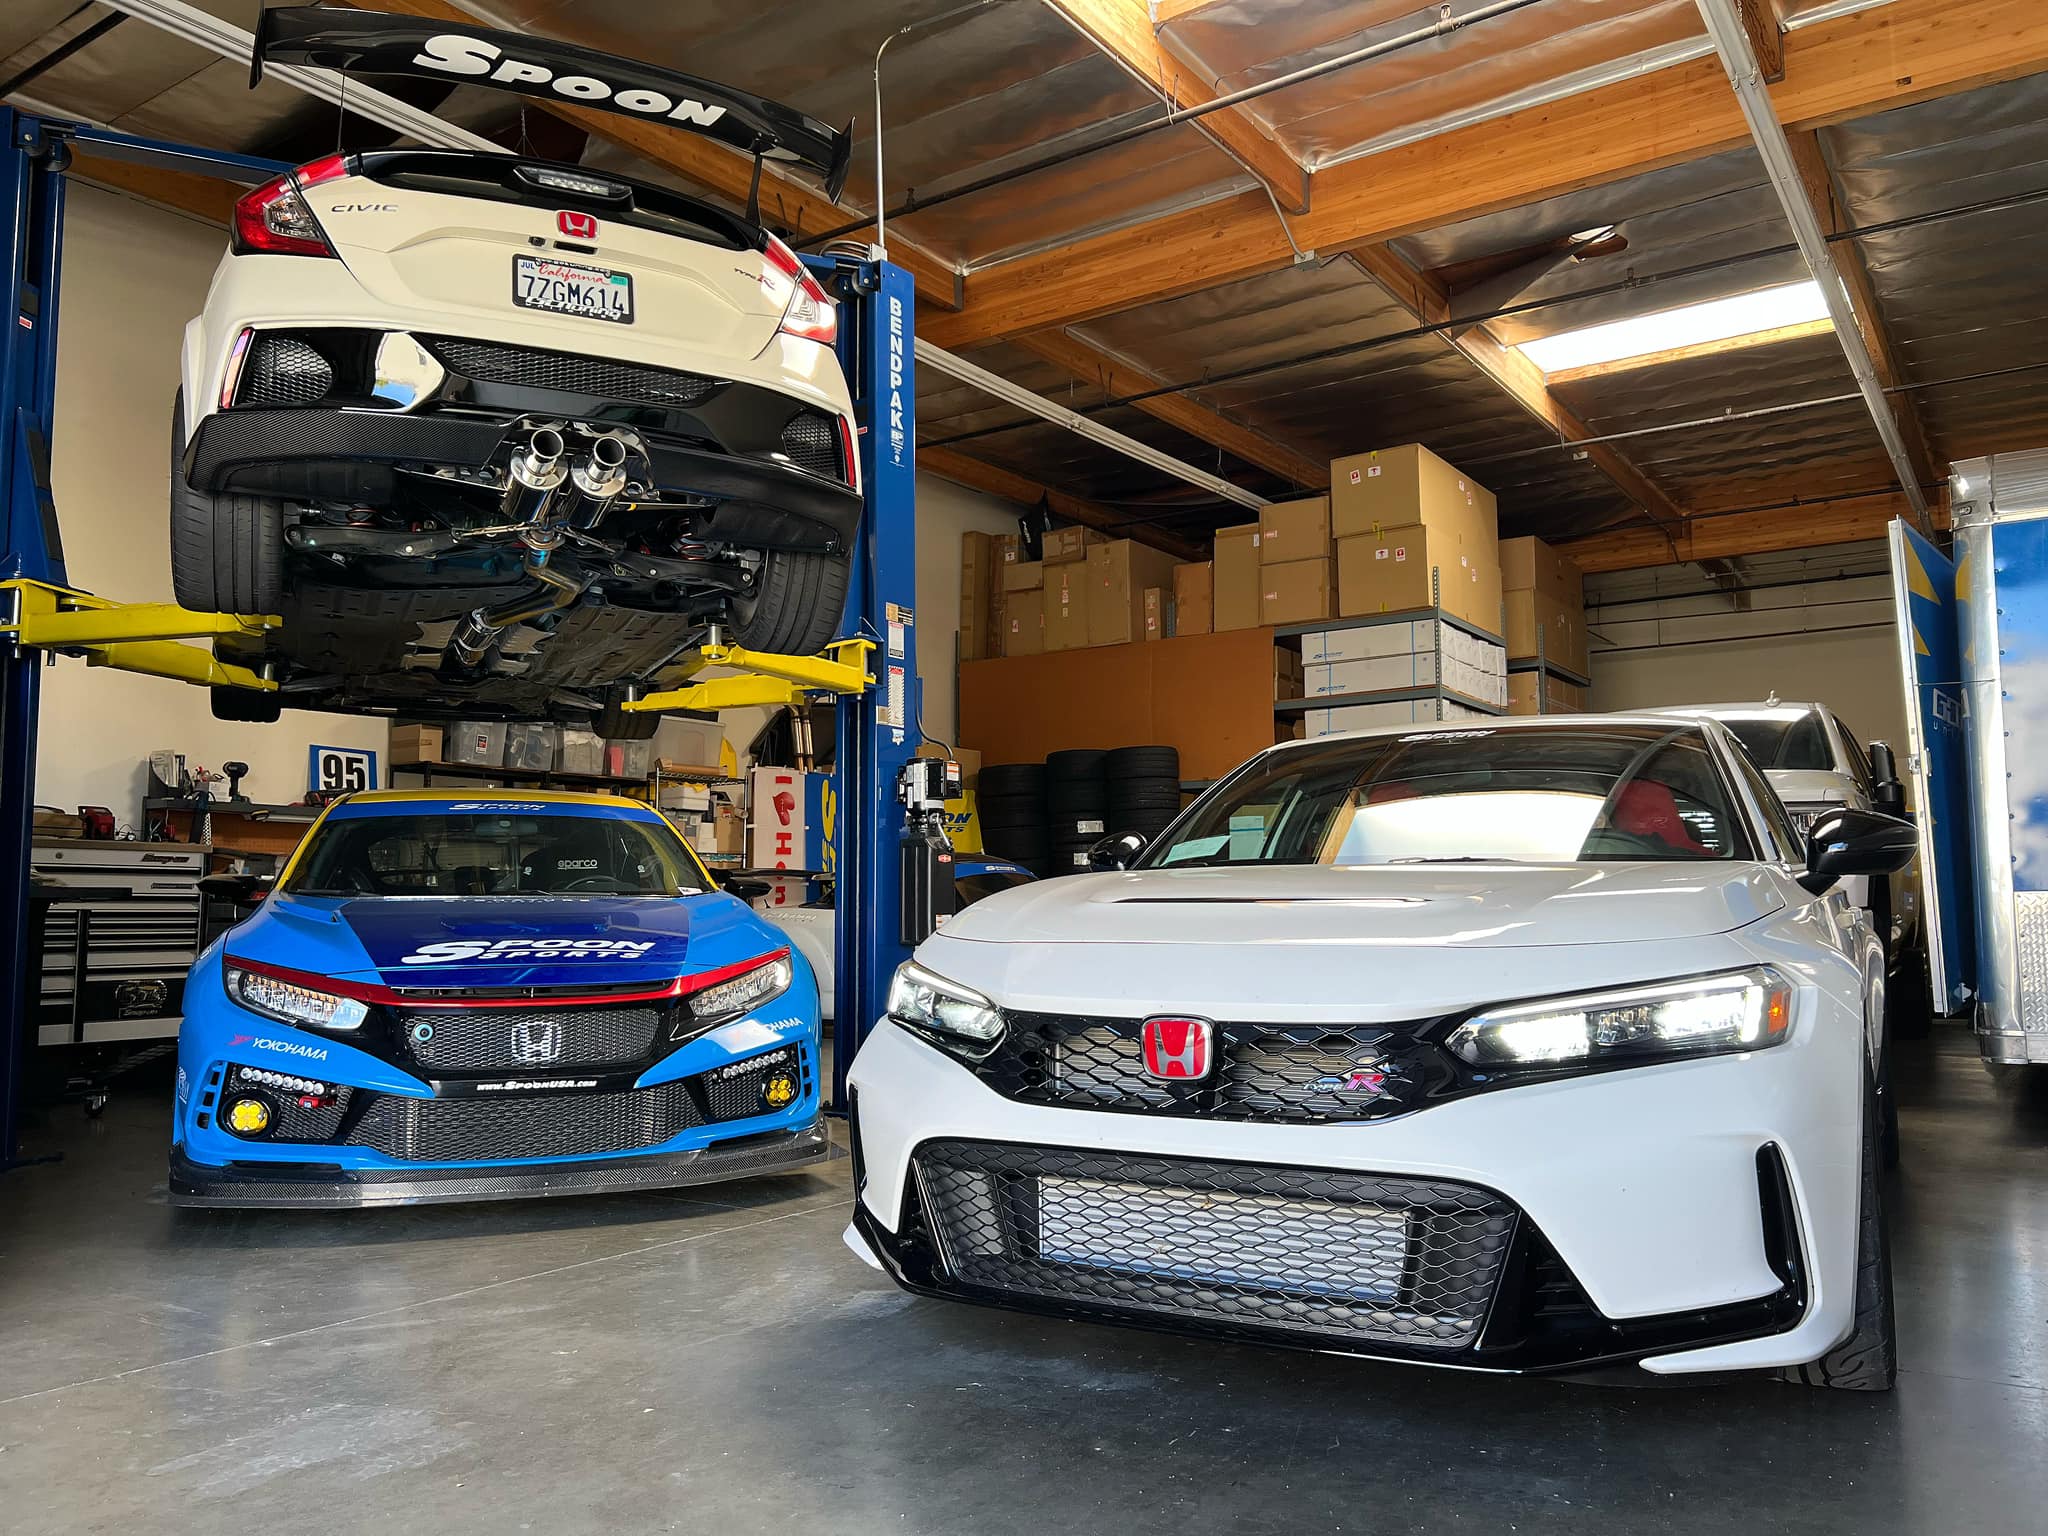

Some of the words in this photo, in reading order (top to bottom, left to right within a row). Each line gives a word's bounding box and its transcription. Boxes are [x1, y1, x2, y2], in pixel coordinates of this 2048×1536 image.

[412, 34, 727, 127] SPOON
[331, 204, 399, 212] CIVIC
[520, 261, 535, 270] JUL
[538, 262, 610, 286] California
[521, 274, 625, 312] 7ZGM614
[889, 296, 903, 430] BENDPAK
[322, 753, 366, 793] 95
[557, 859, 598, 871] sparco
[401, 939, 656, 965] SPOON
[477, 950, 643, 960] SPORTS
[252, 1037, 328, 1061] YOKOHAMA
